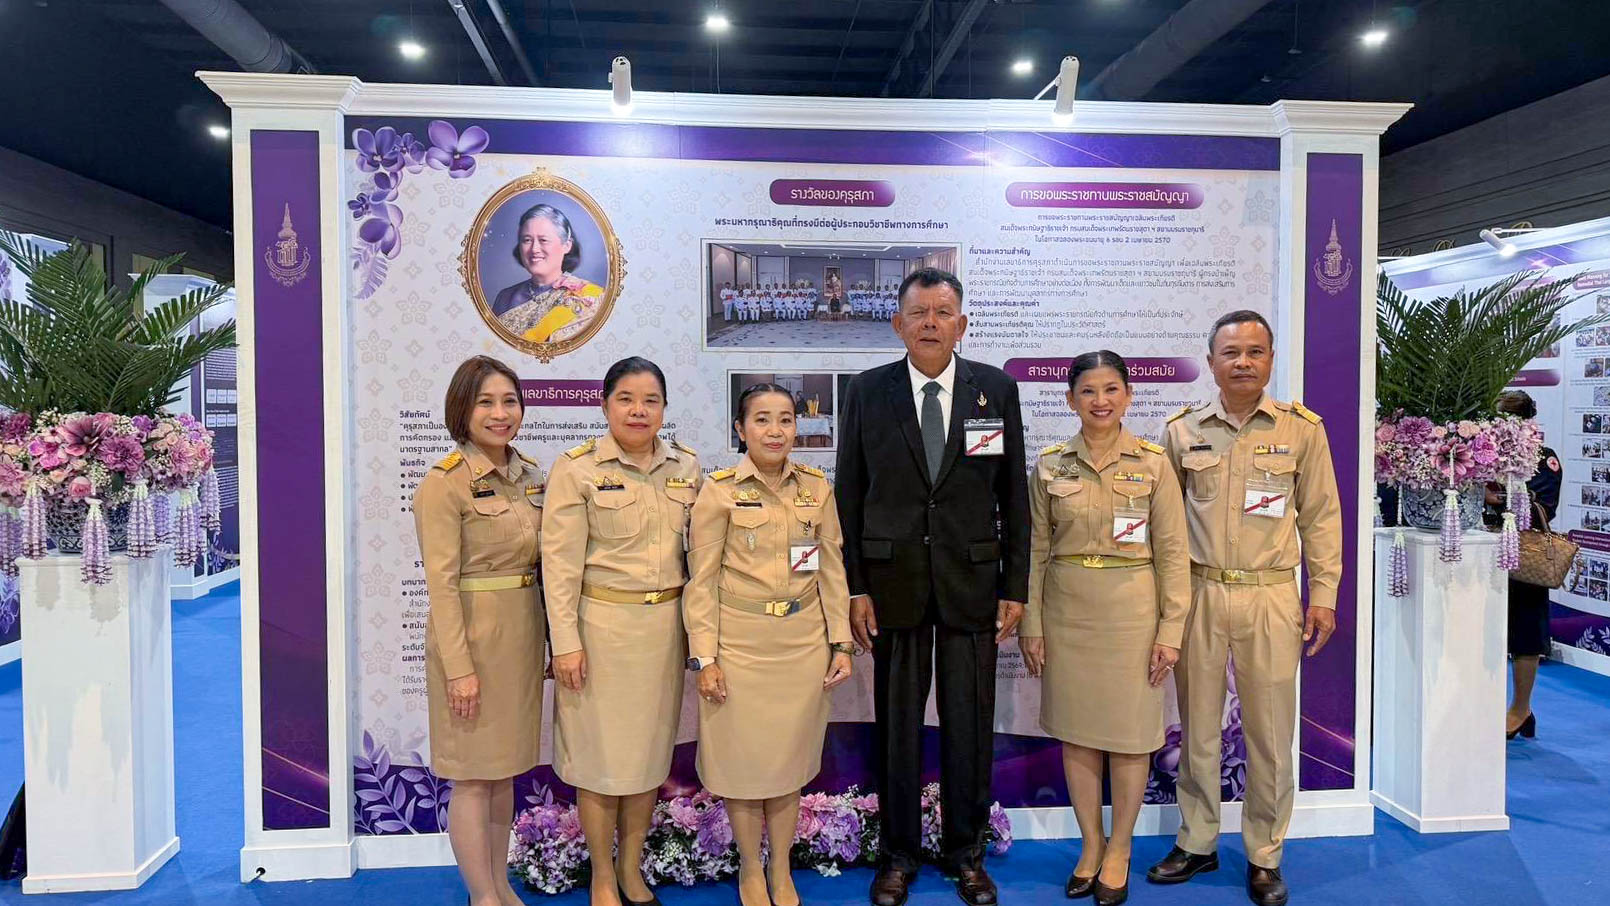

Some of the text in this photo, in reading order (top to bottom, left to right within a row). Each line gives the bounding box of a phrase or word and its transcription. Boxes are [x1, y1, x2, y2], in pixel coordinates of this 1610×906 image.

[790, 186, 875, 204] รางวัลของคุรุสภา
[1020, 189, 1189, 204] การขอพระราชทานพระราชสมัญญา
[714, 214, 949, 231] พระมหากรุณาธิคุณที่ทรงมีต่อผู้ประกอบวิชาชีพทางการศึกษา
[1028, 366, 1071, 379] สารานุก
[399, 410, 431, 418] วิสัยทัศน์
